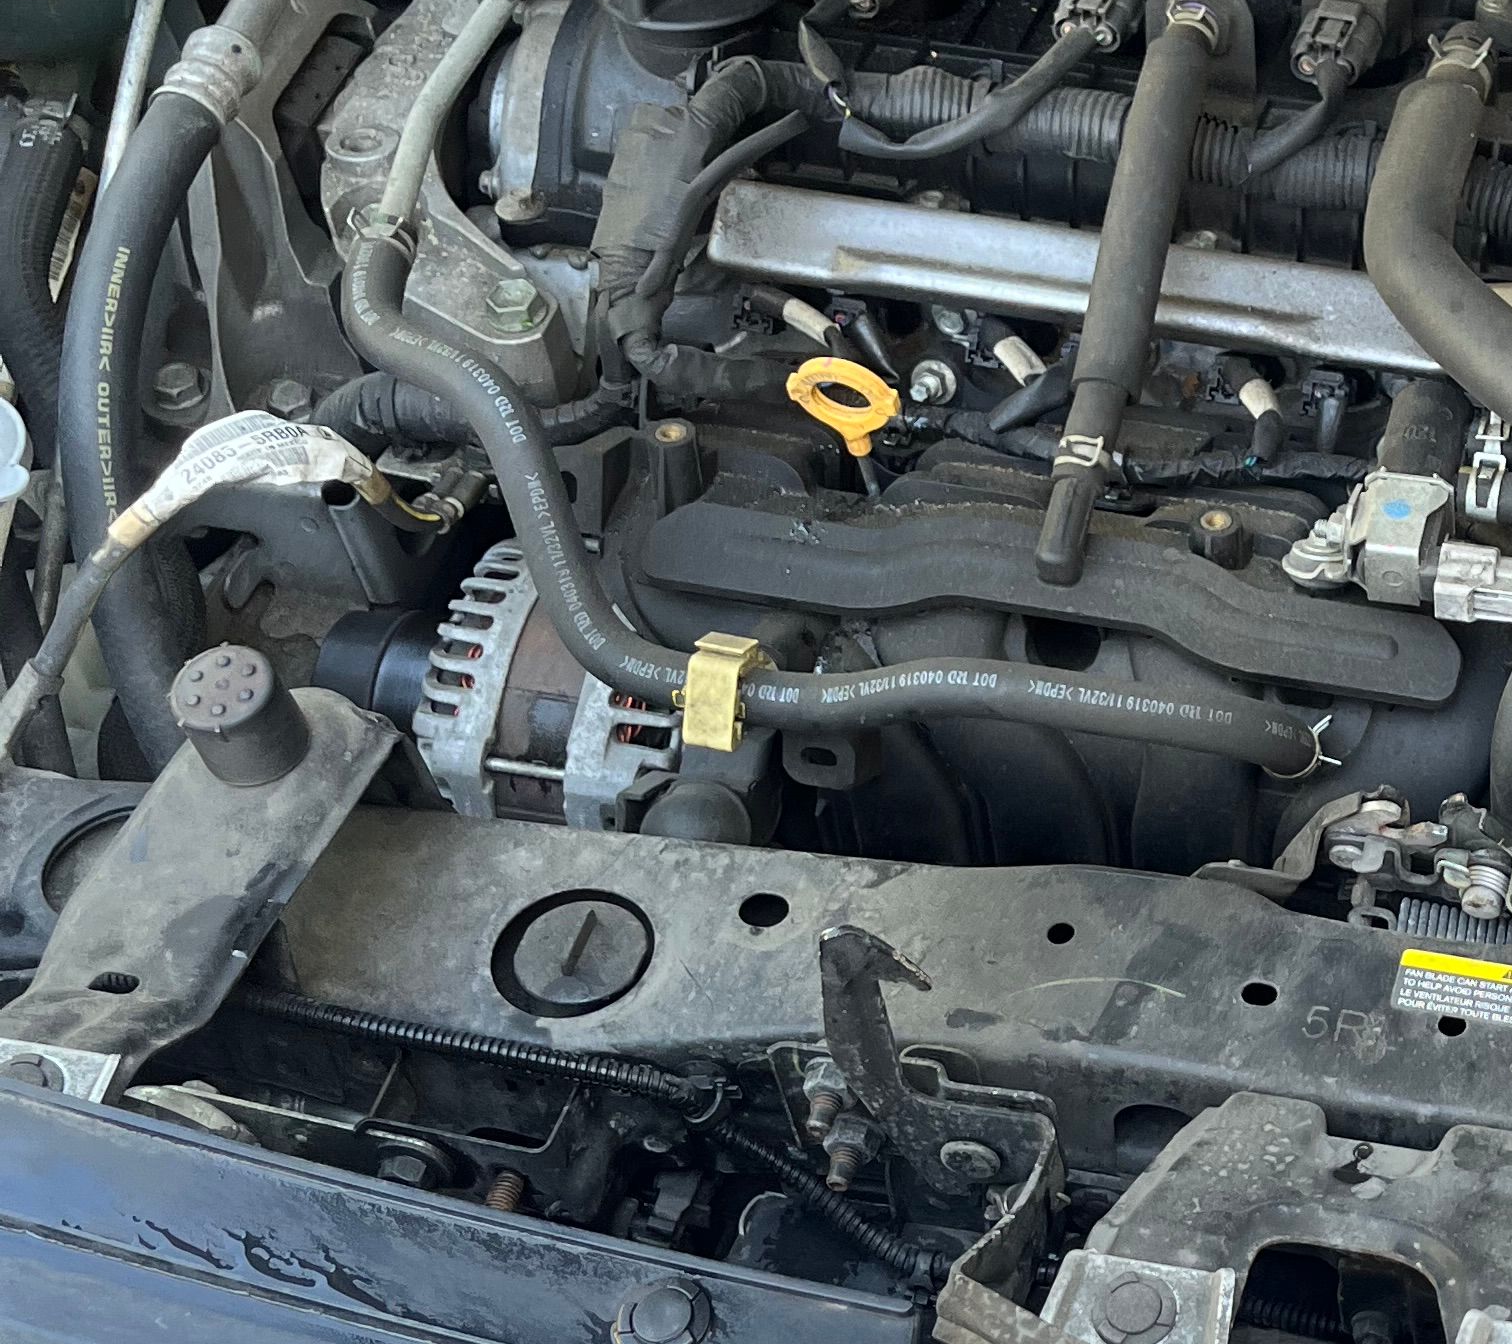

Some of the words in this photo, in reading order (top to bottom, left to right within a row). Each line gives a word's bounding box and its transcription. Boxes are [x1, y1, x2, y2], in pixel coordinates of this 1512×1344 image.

[899, 669, 944, 688] 040319
[973, 672, 998, 688] DOT
[780, 686, 801, 704] DOT
[1126, 694, 1174, 715] 040319
[1208, 708, 1233, 725] DOT
[1403, 977, 1417, 987] TO
[1417, 979, 1443, 991] HELP
[1442, 984, 1473, 997] AVOID
[1404, 968, 1424, 979] FAN
[1424, 971, 1456, 984] BLADE
[1456, 976, 1479, 987] CAN
[1479, 979, 1509, 993] START
[1397, 997, 1426, 1009] POUR
[1459, 1007, 1491, 1020] TOUTE
[1399, 987, 1413, 997] LE
[1413, 990, 1475, 1008] VENTILATEUR
[1474, 999, 1511, 1014] RISQUE
